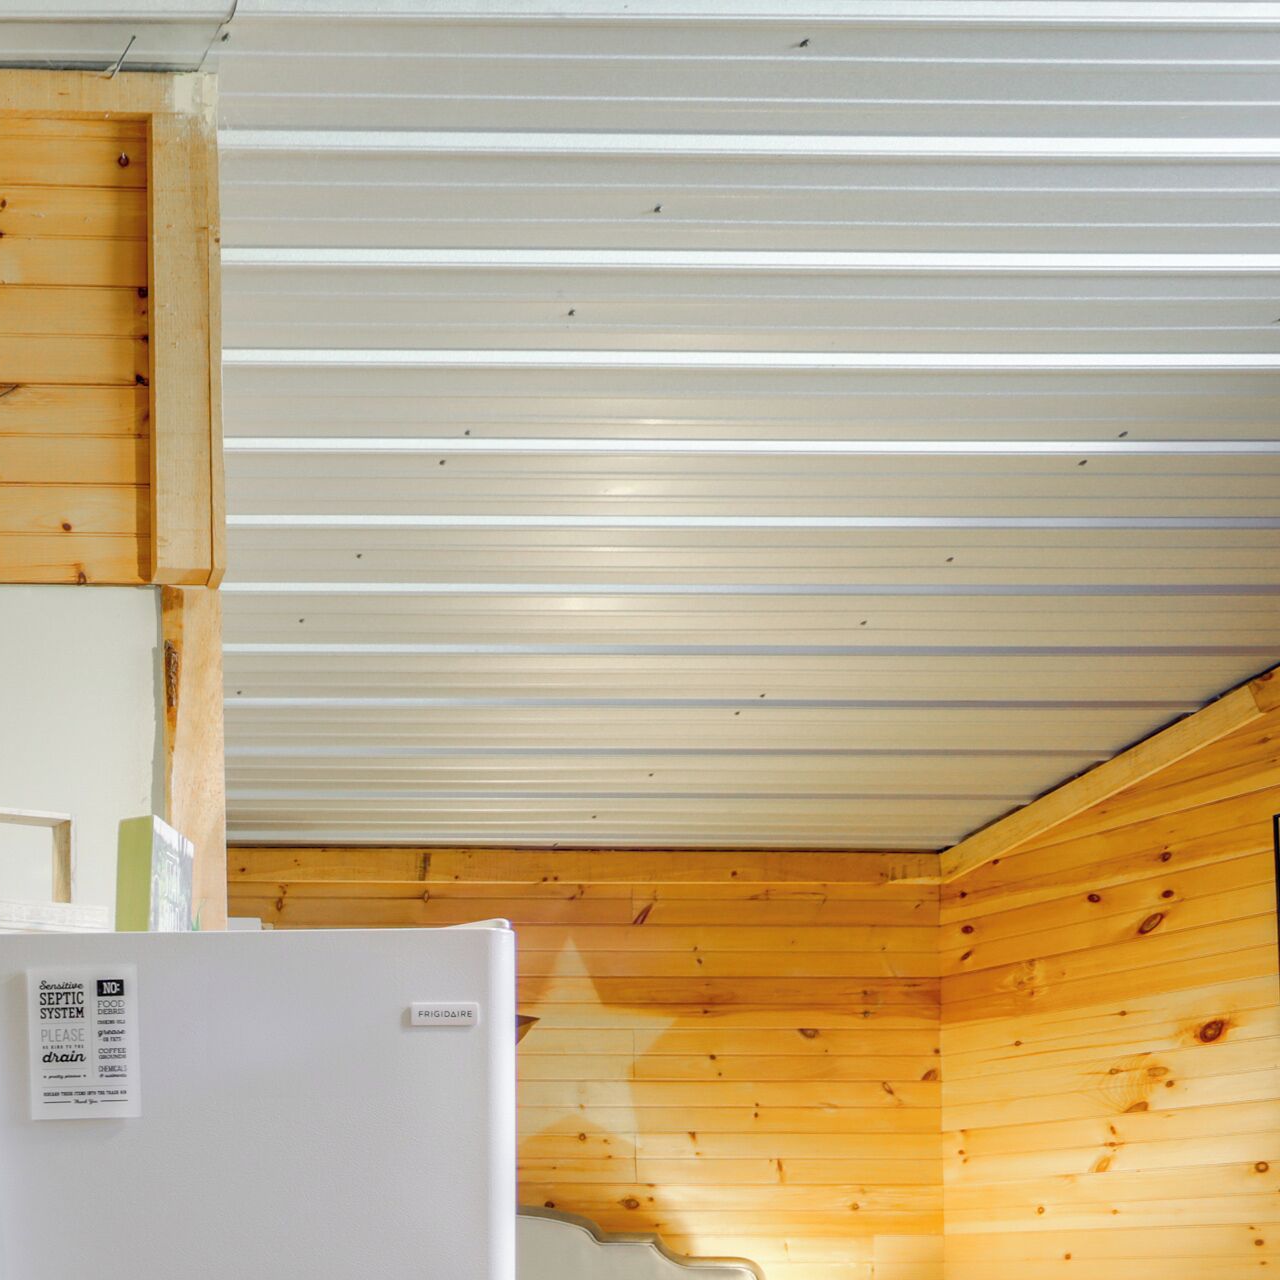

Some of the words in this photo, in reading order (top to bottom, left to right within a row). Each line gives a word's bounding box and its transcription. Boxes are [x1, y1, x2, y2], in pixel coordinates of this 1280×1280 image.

[39, 980, 84, 990] Sensitive
[40, 991, 84, 1006] SEPTIC
[97, 1000, 125, 1008] FOOD
[40, 1007, 84, 1019] SYSTEM
[418, 1010, 473, 1018] FRIGIDAIRE
[41, 1028, 85, 1042] PLEASE
[42, 1050, 86, 1063] drain
